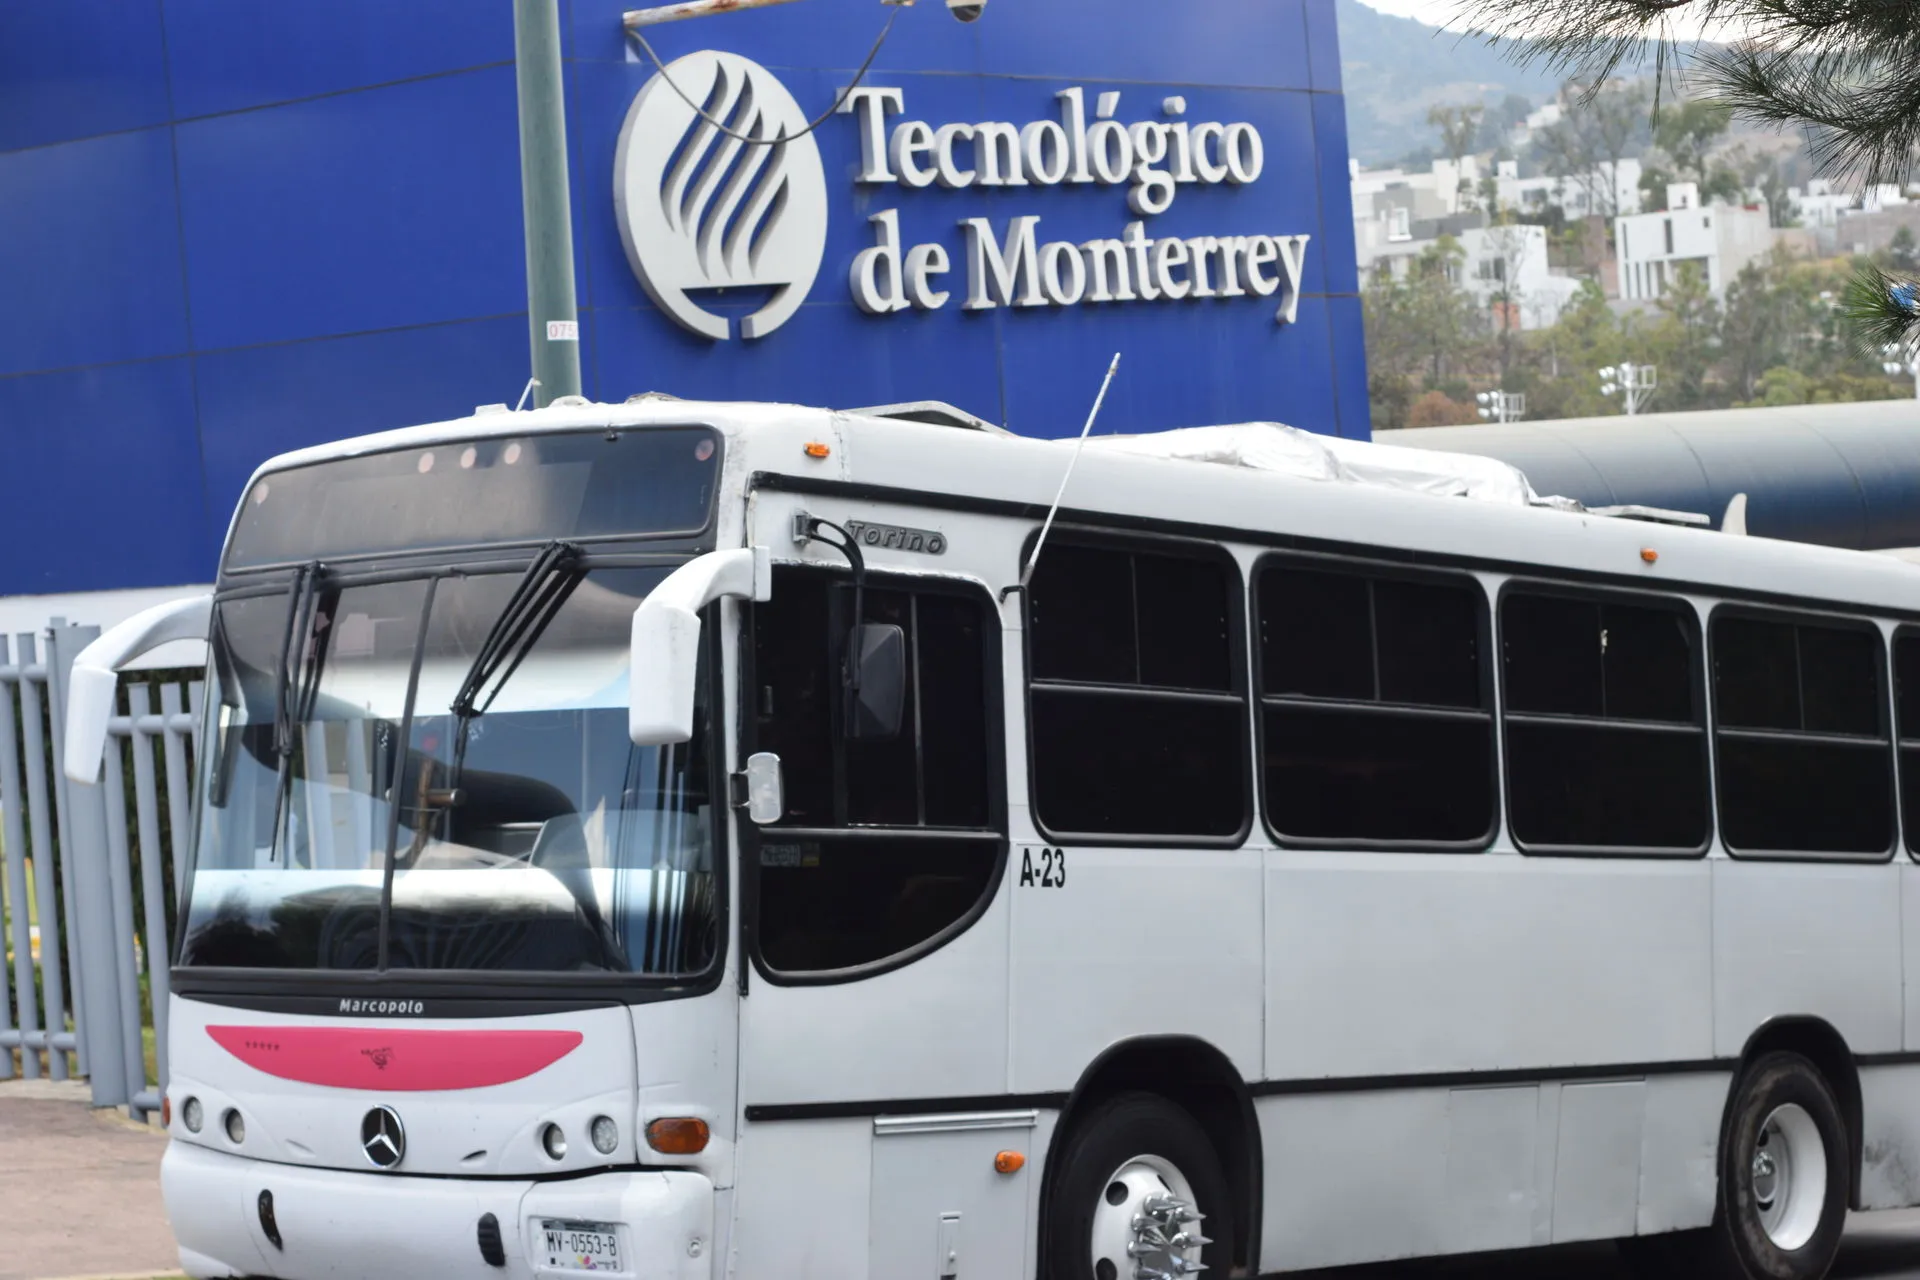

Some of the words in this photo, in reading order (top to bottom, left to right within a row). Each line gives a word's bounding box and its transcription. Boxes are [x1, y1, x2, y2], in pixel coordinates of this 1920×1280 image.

[836, 86, 1264, 214] Tecnológico
[850, 209, 951, 314] de
[958, 215, 1311, 325] Monterrey
[849, 521, 943, 554] Torino
[1019, 847, 1066, 889] A-23
[339, 998, 424, 1014] Marcopolo
[546, 1231, 617, 1257] MV-0553-B
